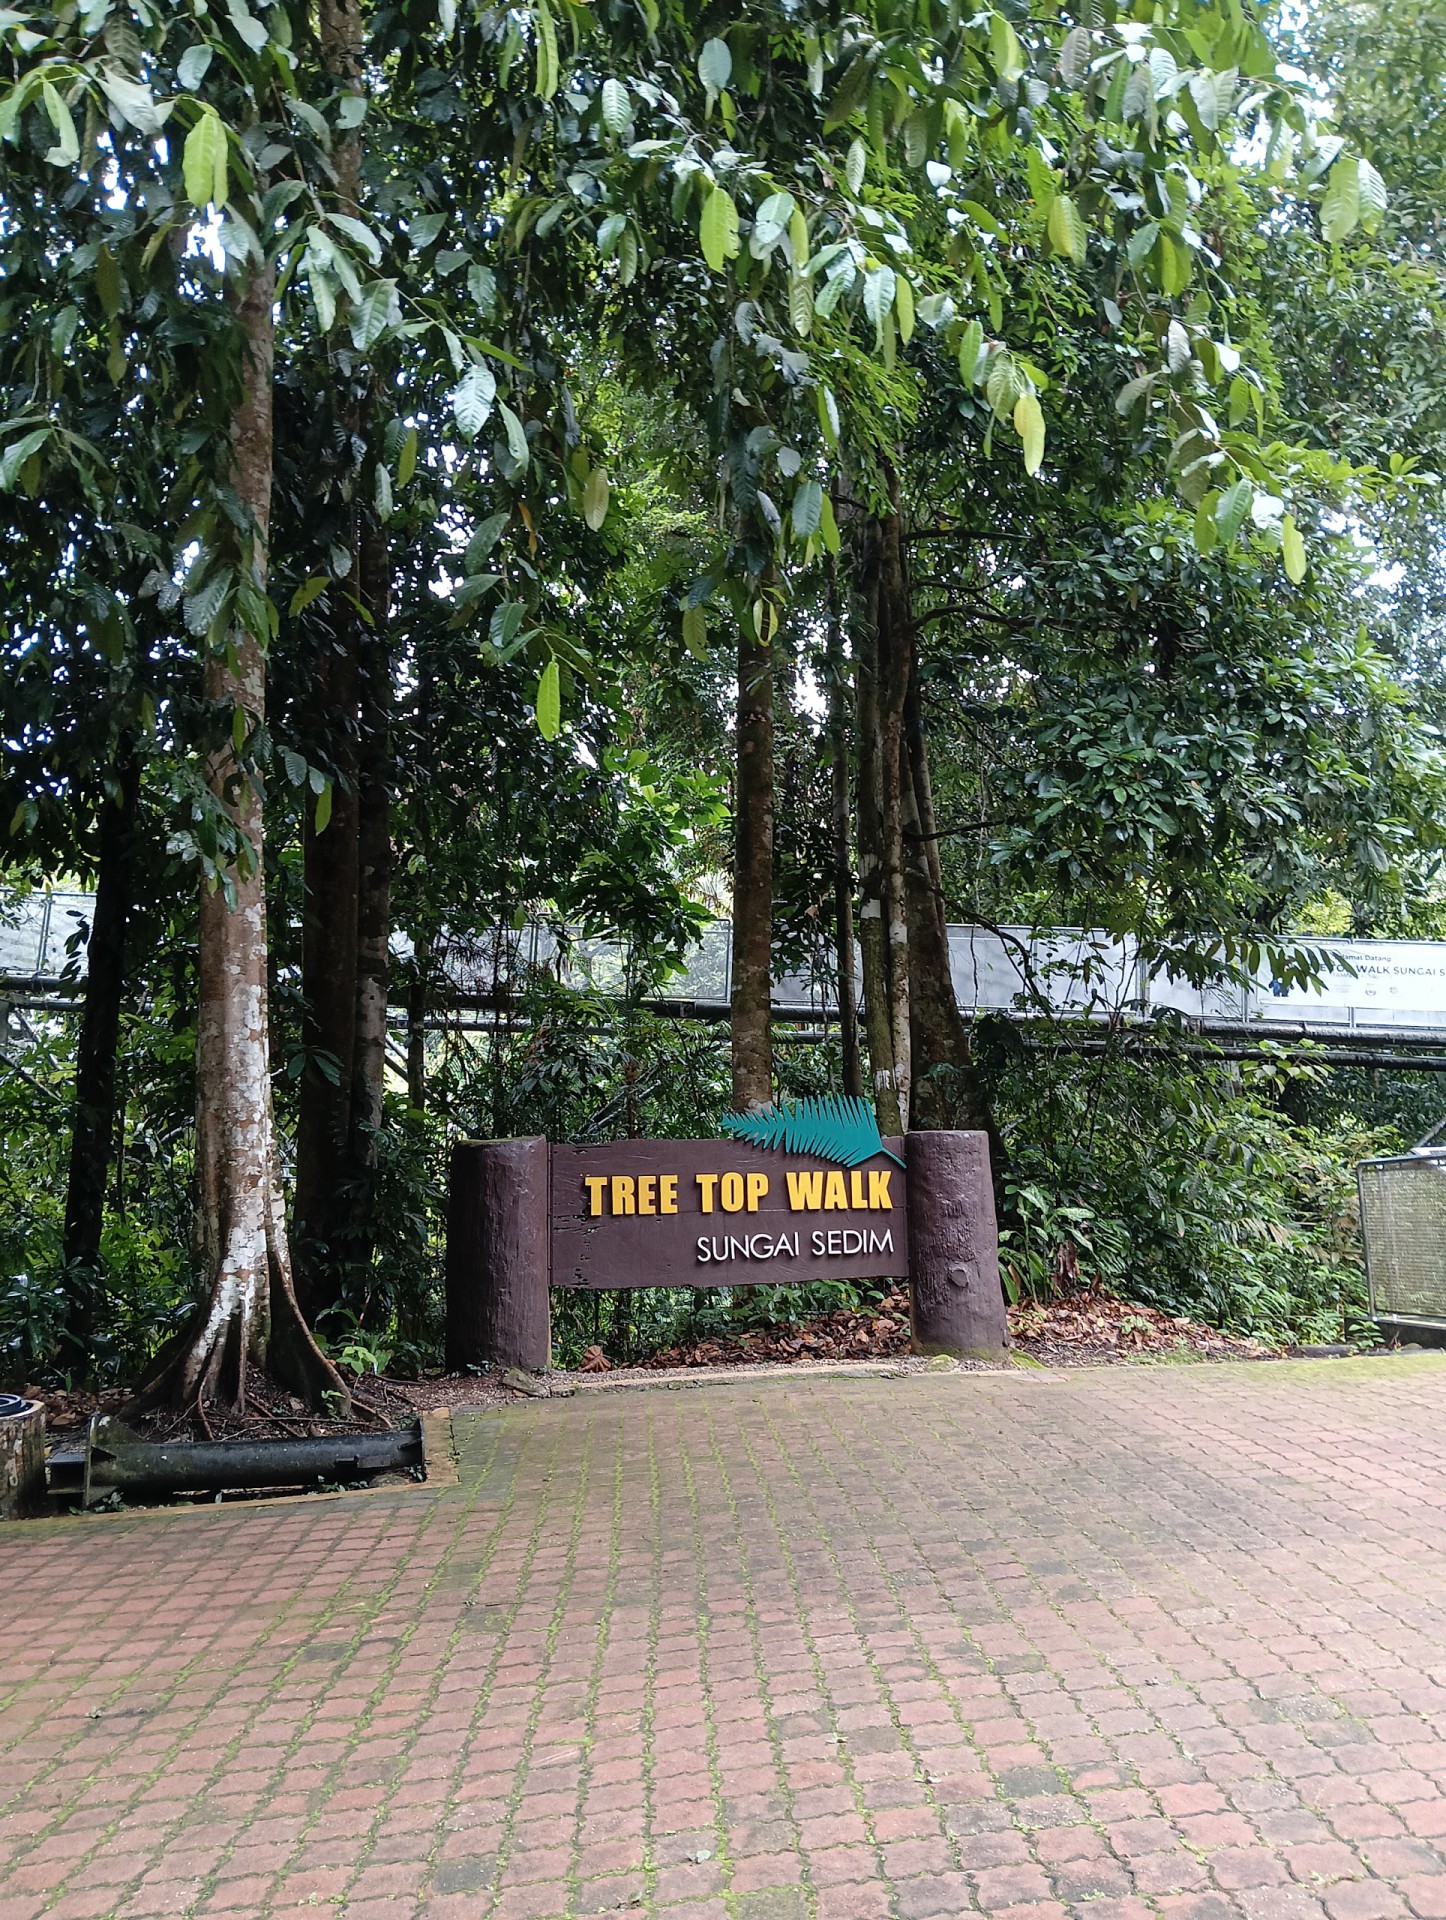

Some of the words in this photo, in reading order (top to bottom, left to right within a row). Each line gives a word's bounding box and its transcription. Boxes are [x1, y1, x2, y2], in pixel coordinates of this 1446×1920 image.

[1356, 965, 1390, 974] WALK
[1393, 966, 1436, 976] SUNGAI
[585, 1174, 679, 1216] TREE
[696, 1172, 769, 1213] TOP
[786, 1170, 893, 1211] WALK
[696, 1232, 800, 1262] SUNGAI
[812, 1229, 895, 1255] SEDIM
